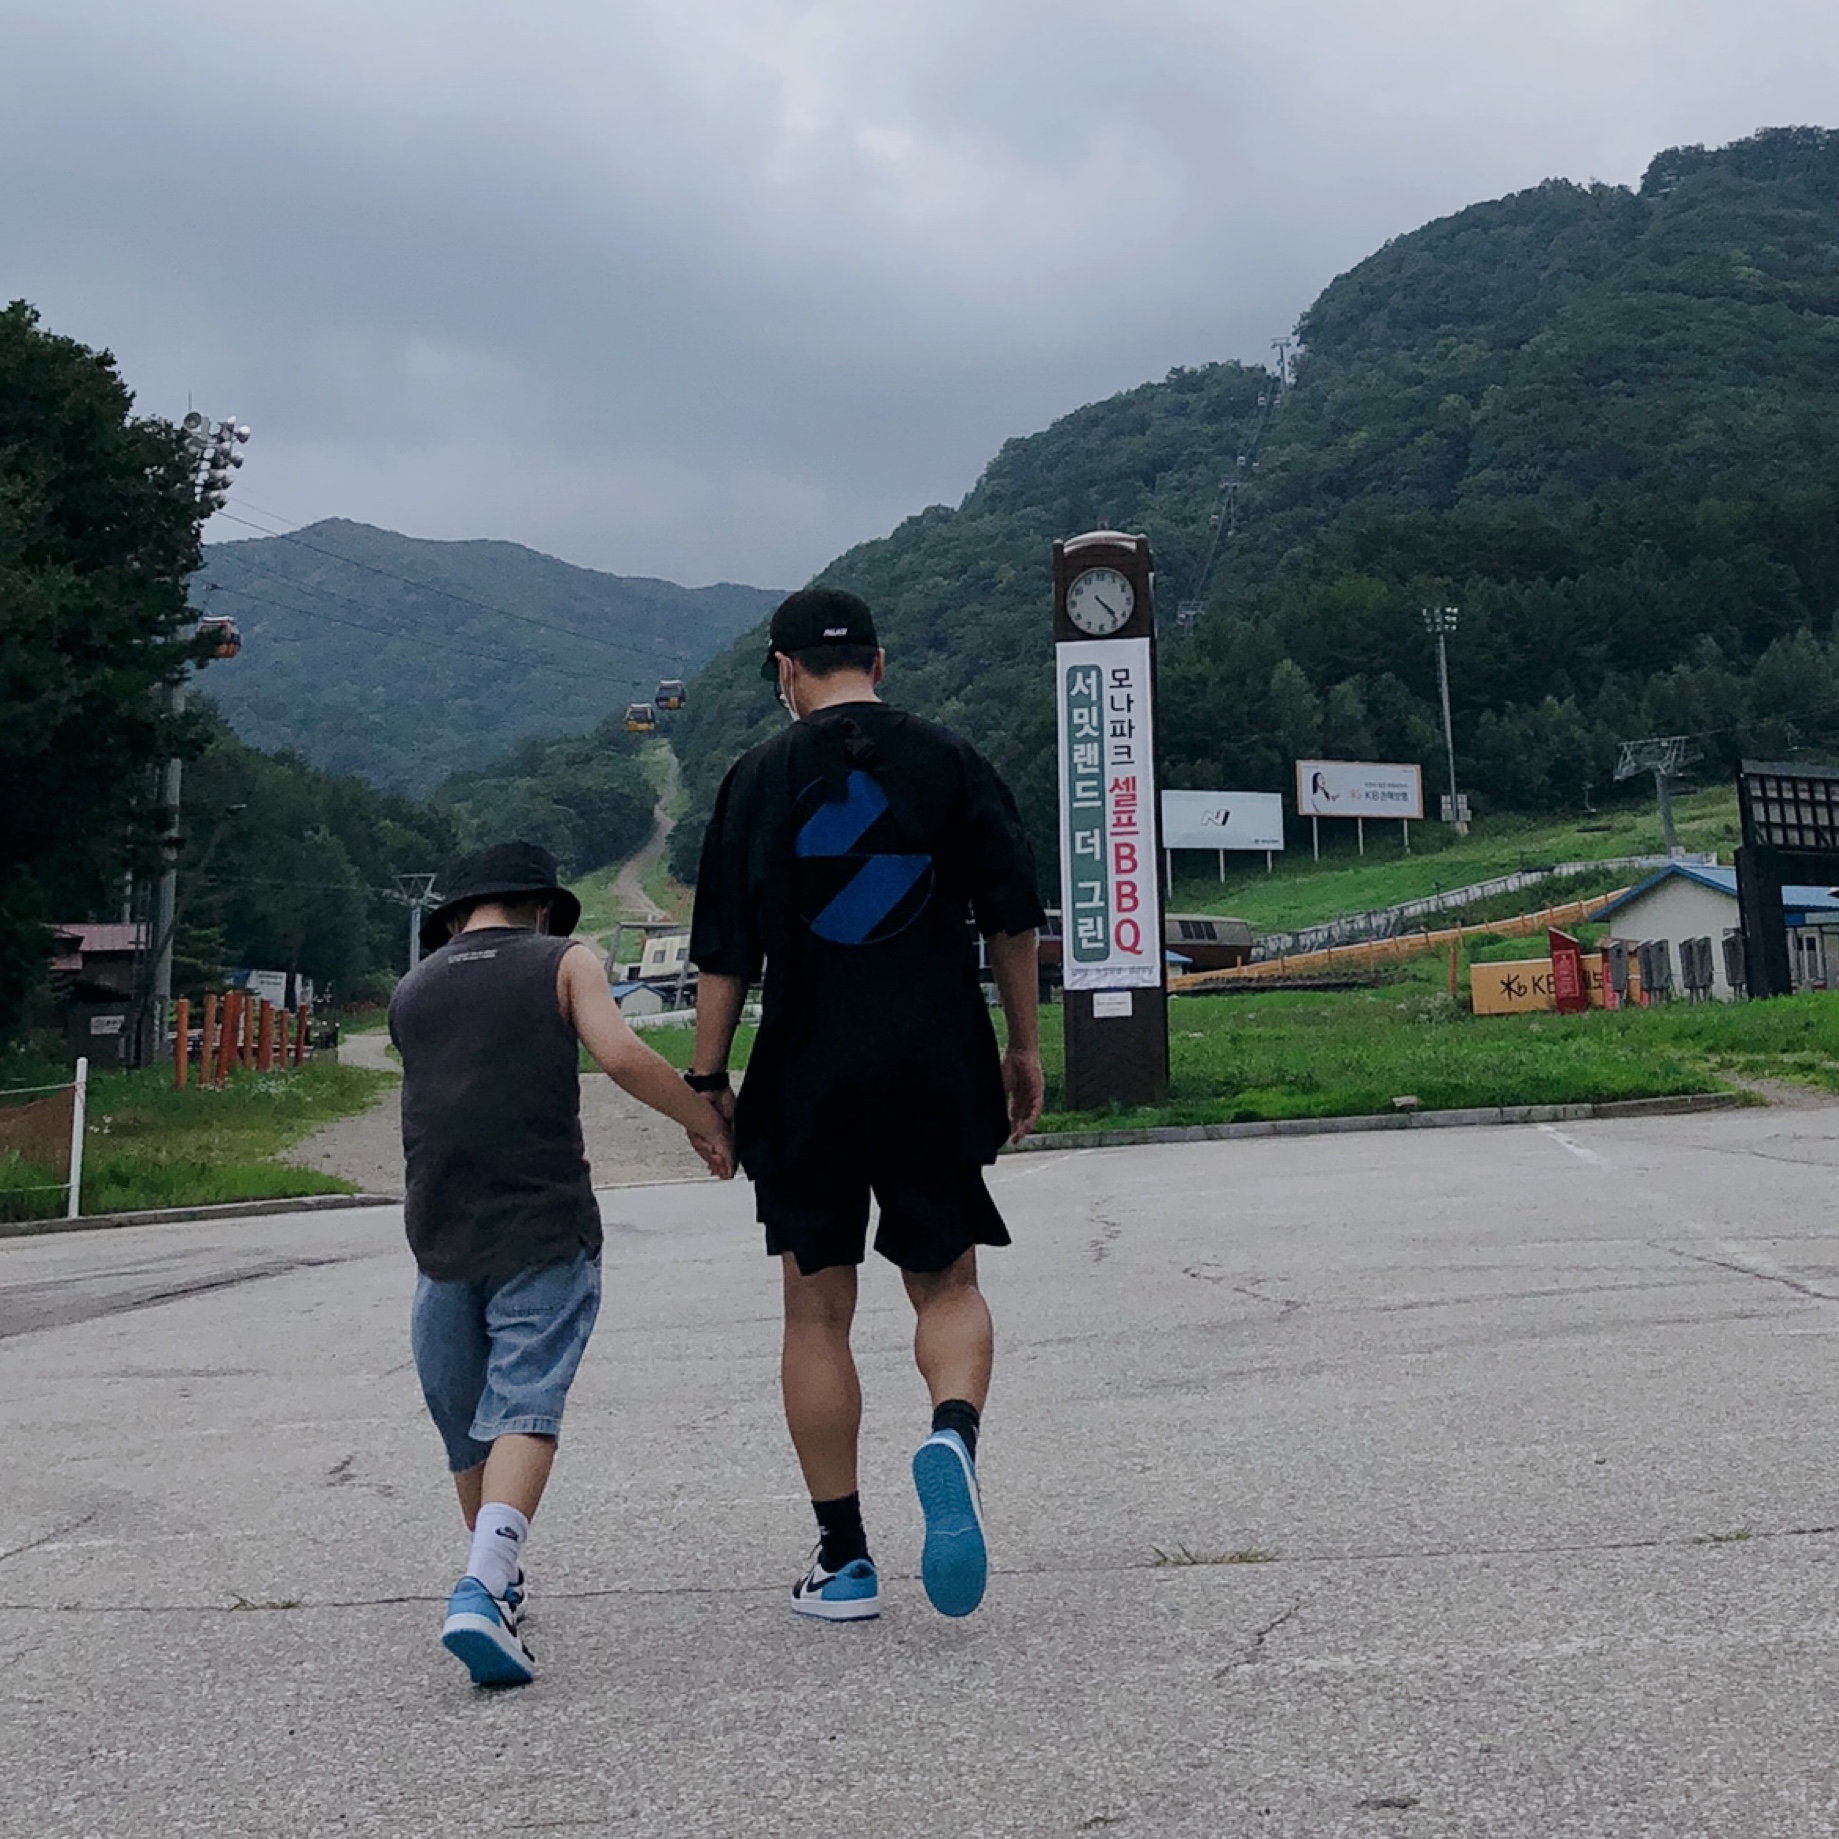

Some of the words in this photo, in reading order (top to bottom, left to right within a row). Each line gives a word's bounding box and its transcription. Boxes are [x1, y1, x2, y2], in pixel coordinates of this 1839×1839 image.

[1069, 670, 1102, 808] 서밋랜드
[1109, 668, 1135, 765] 모나파크
[1075, 828, 1101, 861] 더
[1075, 881, 1105, 949] 그린
